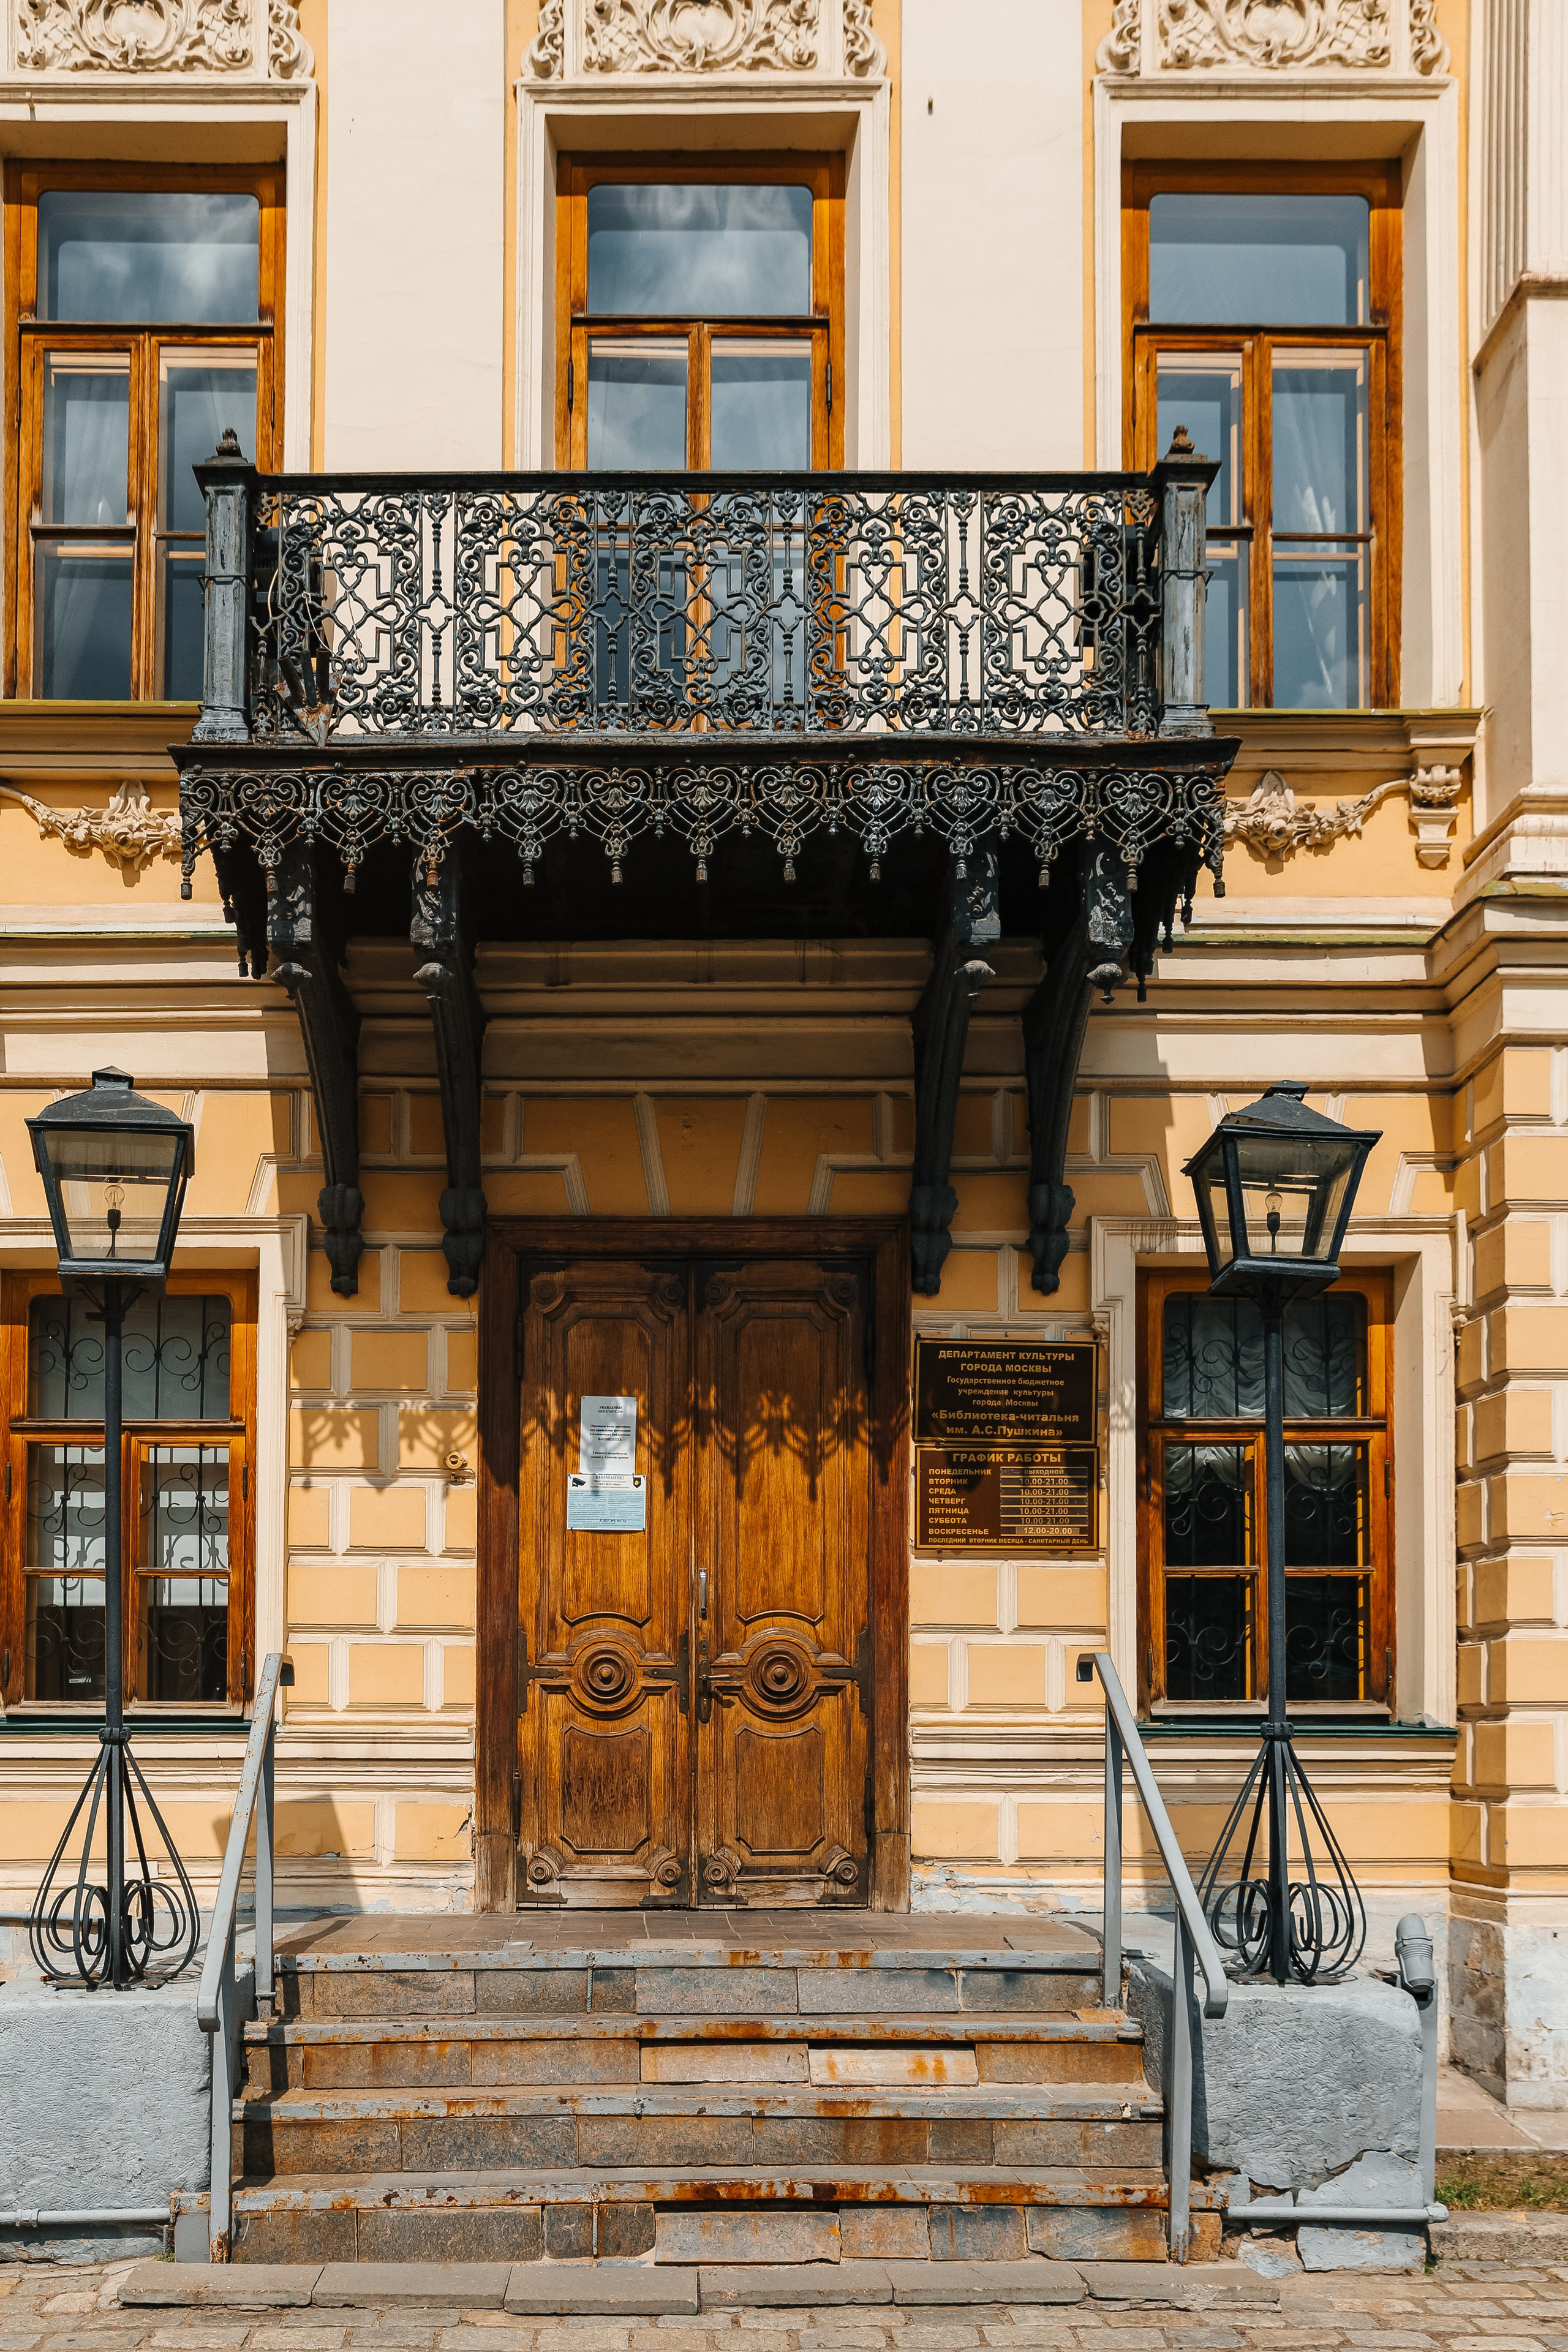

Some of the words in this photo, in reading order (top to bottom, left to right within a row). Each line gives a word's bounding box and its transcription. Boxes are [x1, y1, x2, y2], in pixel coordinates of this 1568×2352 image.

[938, 1350, 1016, 1360] ДЕПАРТАМЕНТ
[960, 1363, 1002, 1372] ГОРОДА
[948, 1376, 1016, 1385] Государственное
[932, 1410, 1079, 1422] «Библиотека-читальня
[946, 1426, 967, 1434] им.
[972, 1425, 1063, 1437] А.С.Пушкина»
[953, 1453, 1003, 1463] ГРАФИК
[1008, 1454, 1061, 1463] РАБОТЫ
